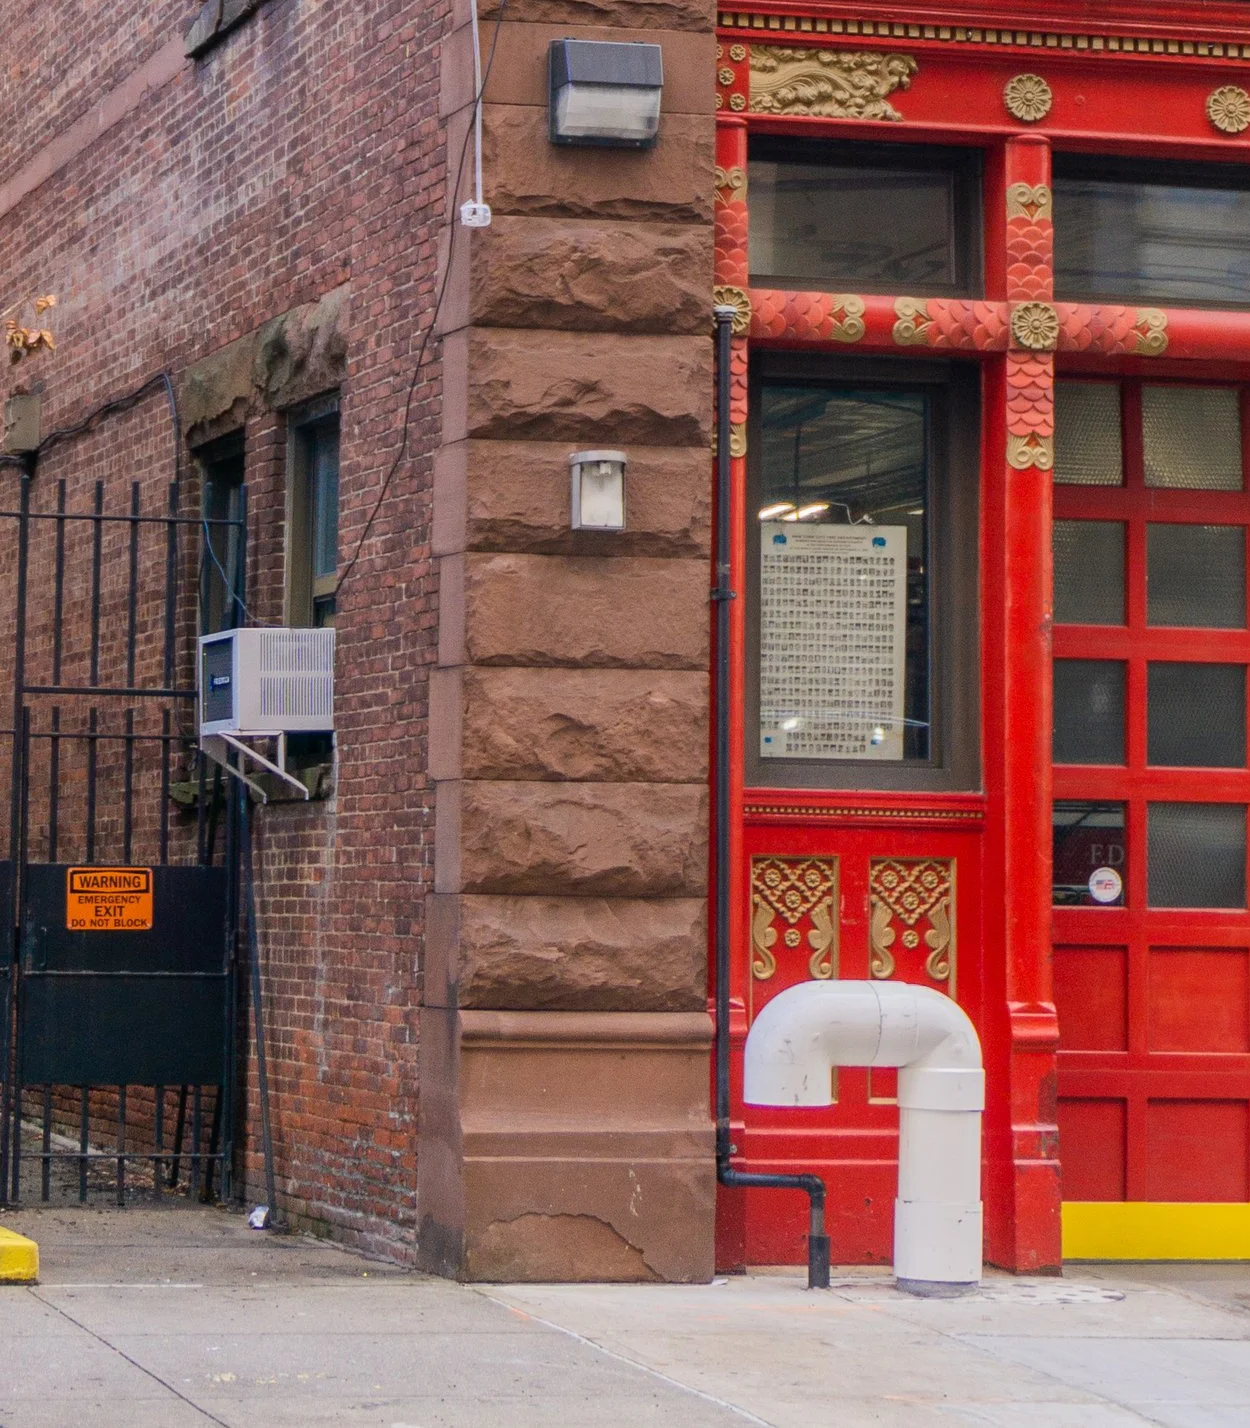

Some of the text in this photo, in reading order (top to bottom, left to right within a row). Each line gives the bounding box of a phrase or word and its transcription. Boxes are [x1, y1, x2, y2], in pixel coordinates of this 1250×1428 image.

[80, 876, 141, 888] WARNING
[78, 896, 141, 904] EMERGENCY
[95, 906, 125, 917] EXIT
[72, 919, 147, 927] DO NOT BLOCK
